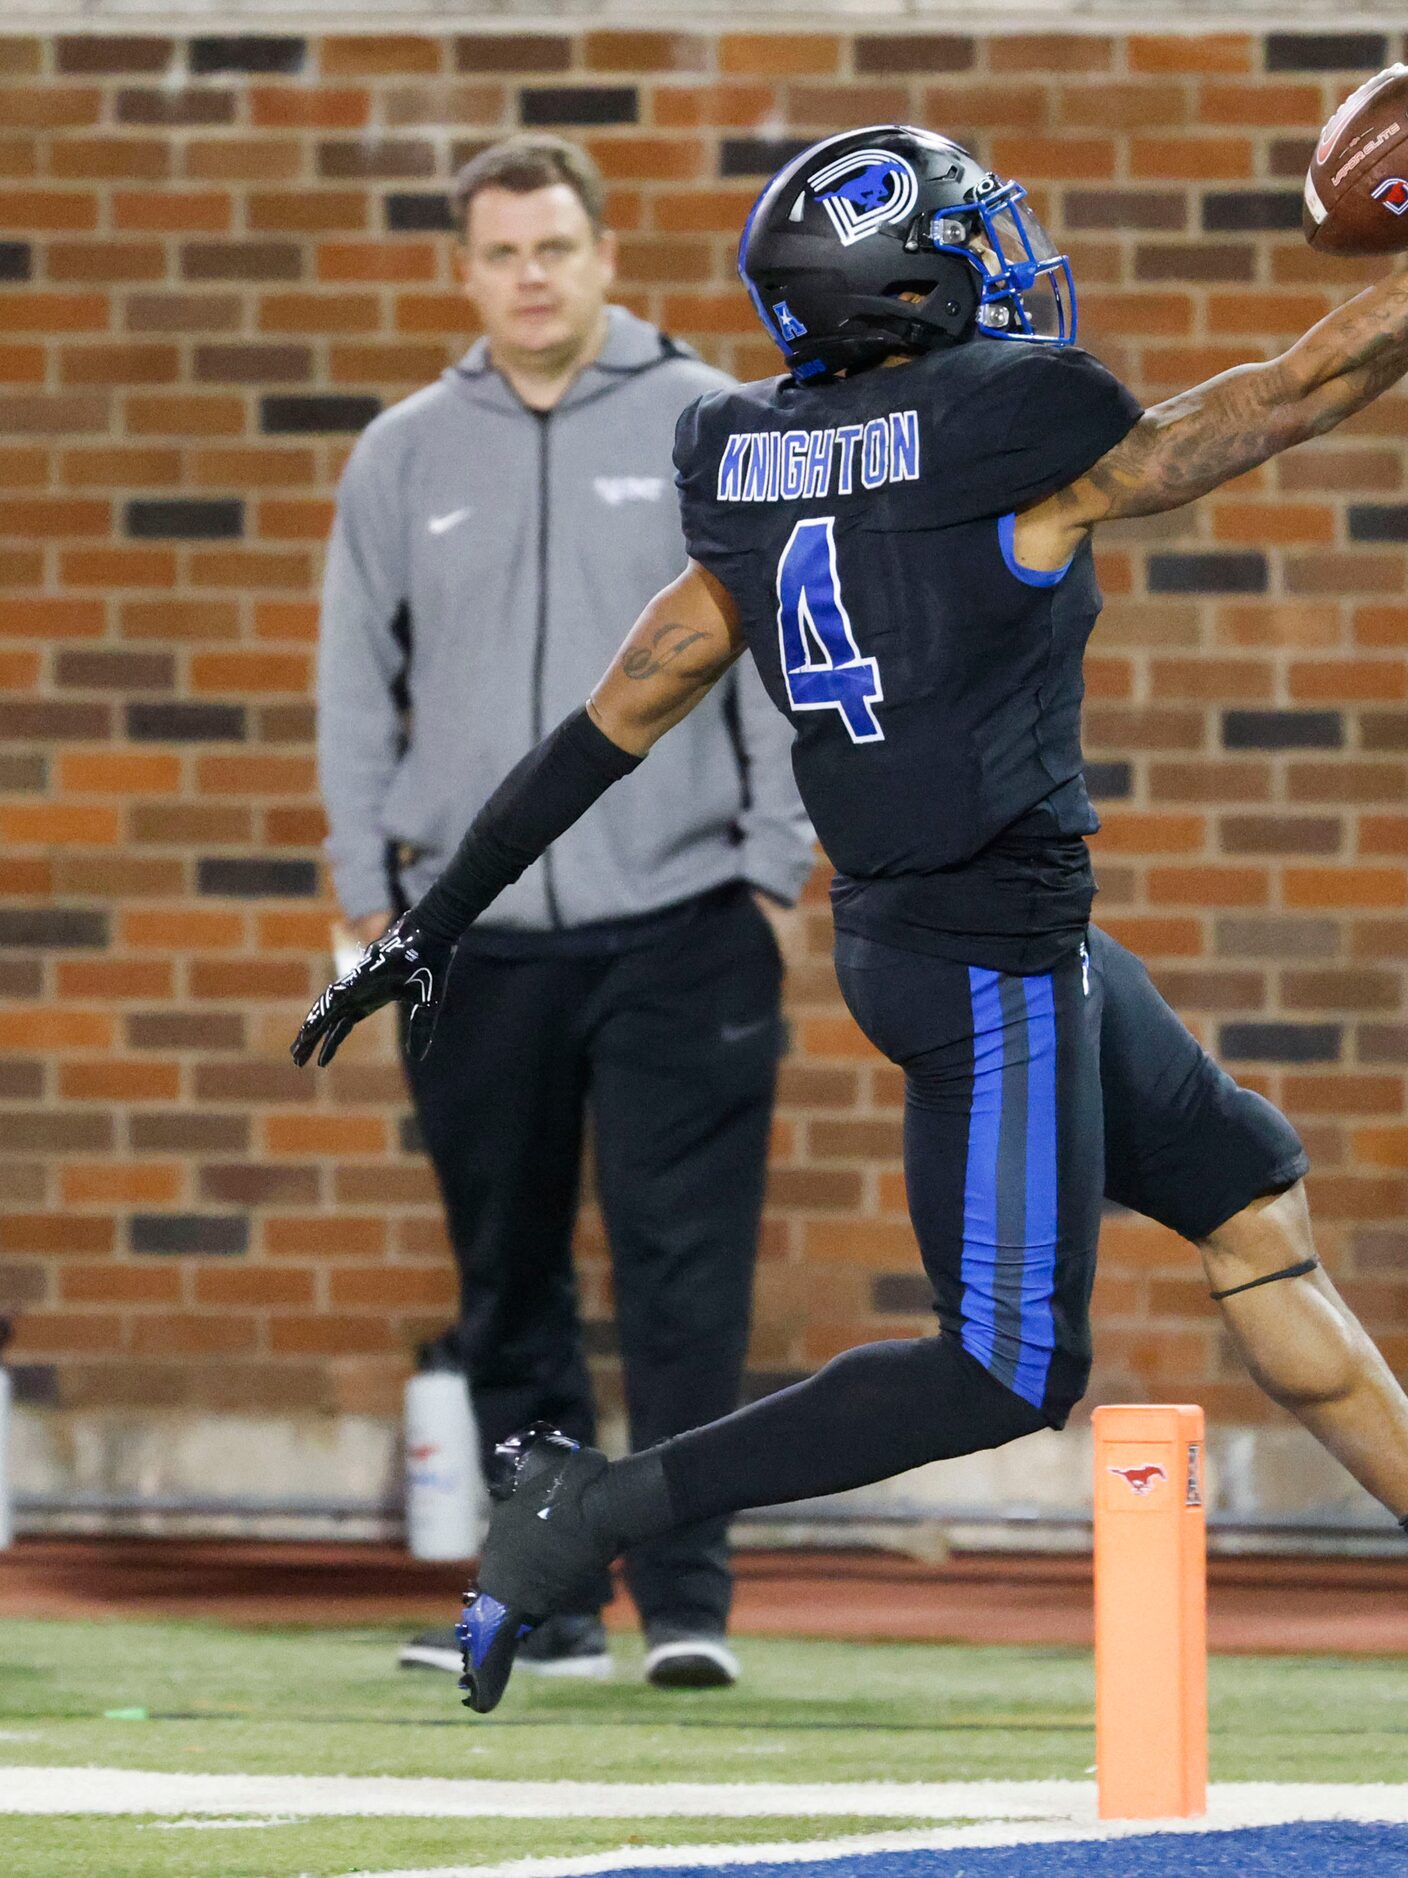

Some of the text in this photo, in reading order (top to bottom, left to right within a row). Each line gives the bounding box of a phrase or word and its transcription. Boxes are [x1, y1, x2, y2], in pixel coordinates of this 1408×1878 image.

[1363, 122, 1400, 155] ELITE
[717, 410, 920, 502] KNIGHTON
[776, 517, 885, 744] 4
